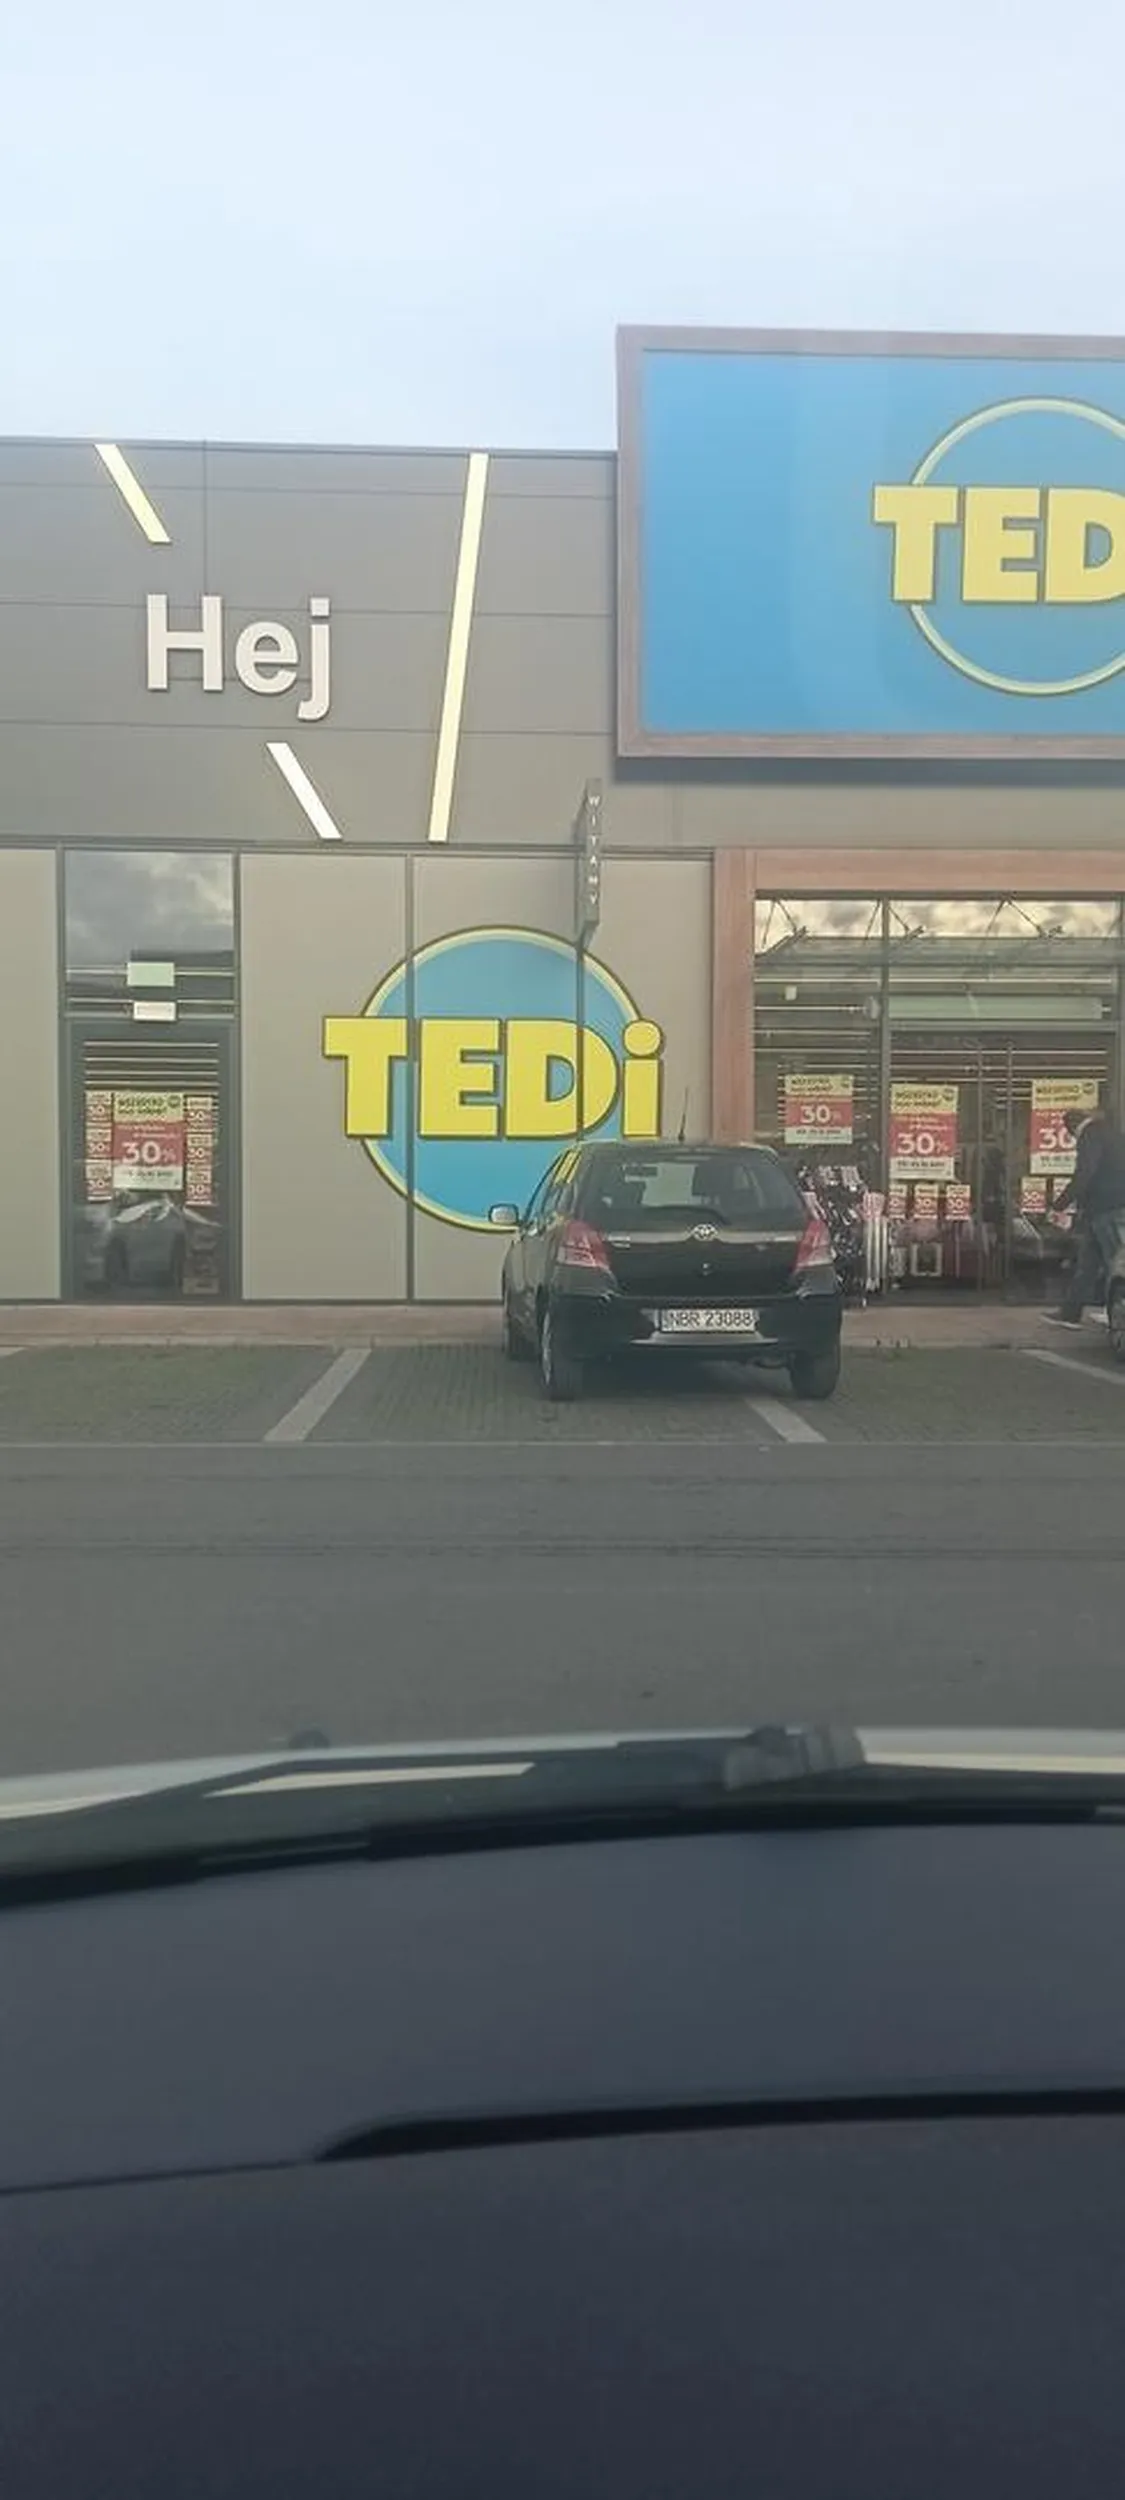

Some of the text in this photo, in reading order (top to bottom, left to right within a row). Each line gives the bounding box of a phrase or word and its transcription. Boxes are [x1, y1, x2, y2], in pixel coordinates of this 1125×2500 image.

[873, 484, 1125, 605] TED
[147, 594, 330, 722] Hej
[323, 1016, 662, 1138] TEDi
[121, 1141, 177, 1163] 30%
[897, 1132, 950, 1154] 30%
[705, 1312, 752, 1327] 23088
